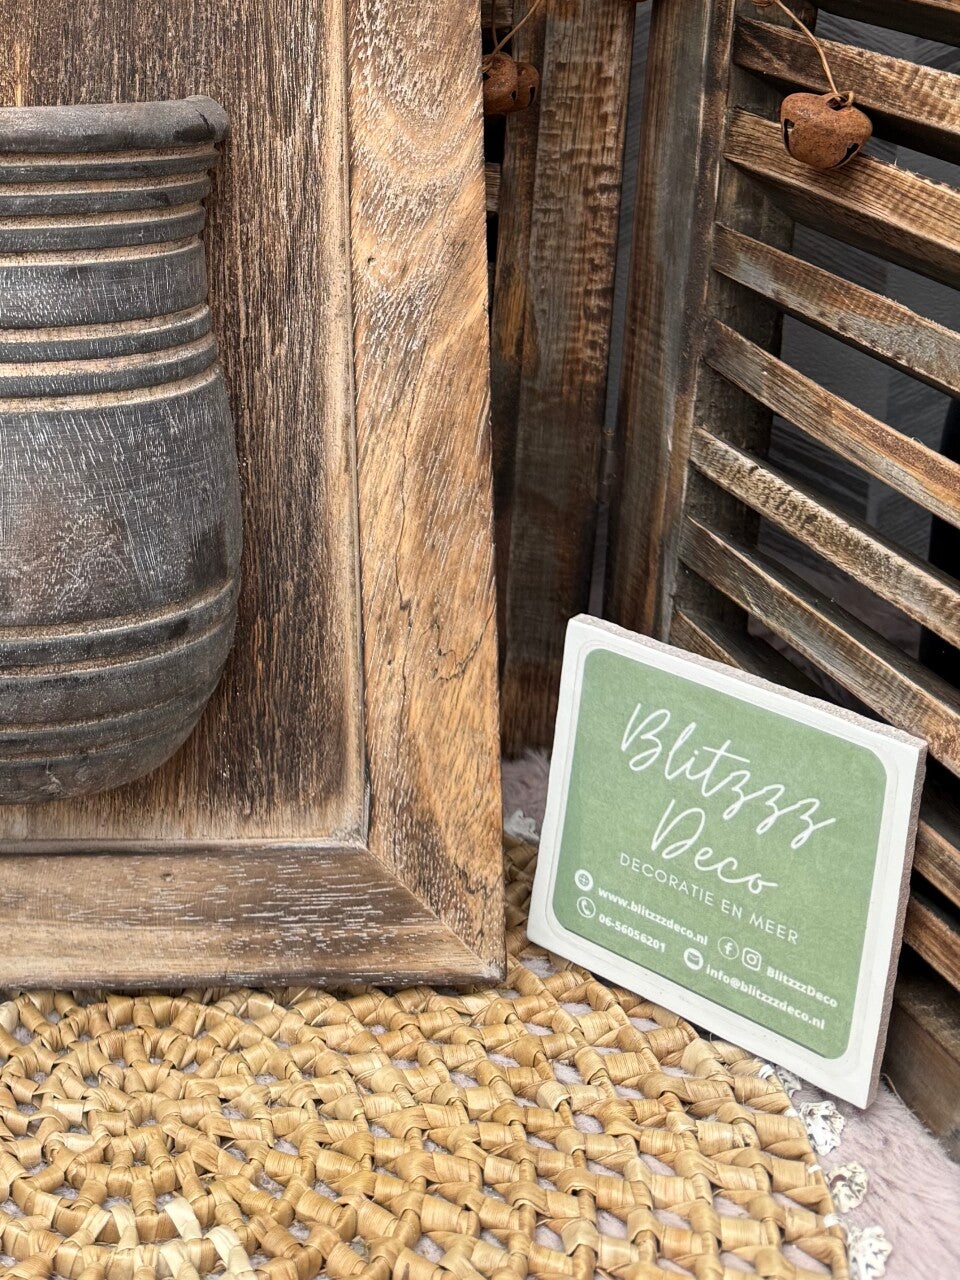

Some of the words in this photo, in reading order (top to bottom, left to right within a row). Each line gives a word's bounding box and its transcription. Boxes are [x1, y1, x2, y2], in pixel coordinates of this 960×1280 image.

[621, 703, 836, 849] Blitzzz
[651, 799, 778, 894] Deco
[598, 887, 708, 946] www.blitzzzdeco.nl
[620, 852, 714, 905] DECORATIE
[721, 899, 743, 919] EN
[749, 912, 799, 945] MEER
[599, 913, 666, 953] 06-56056201
[706, 964, 825, 1030] info@blitzzzdeco.nl
[767, 966, 838, 1008] BlitzzzDeco
